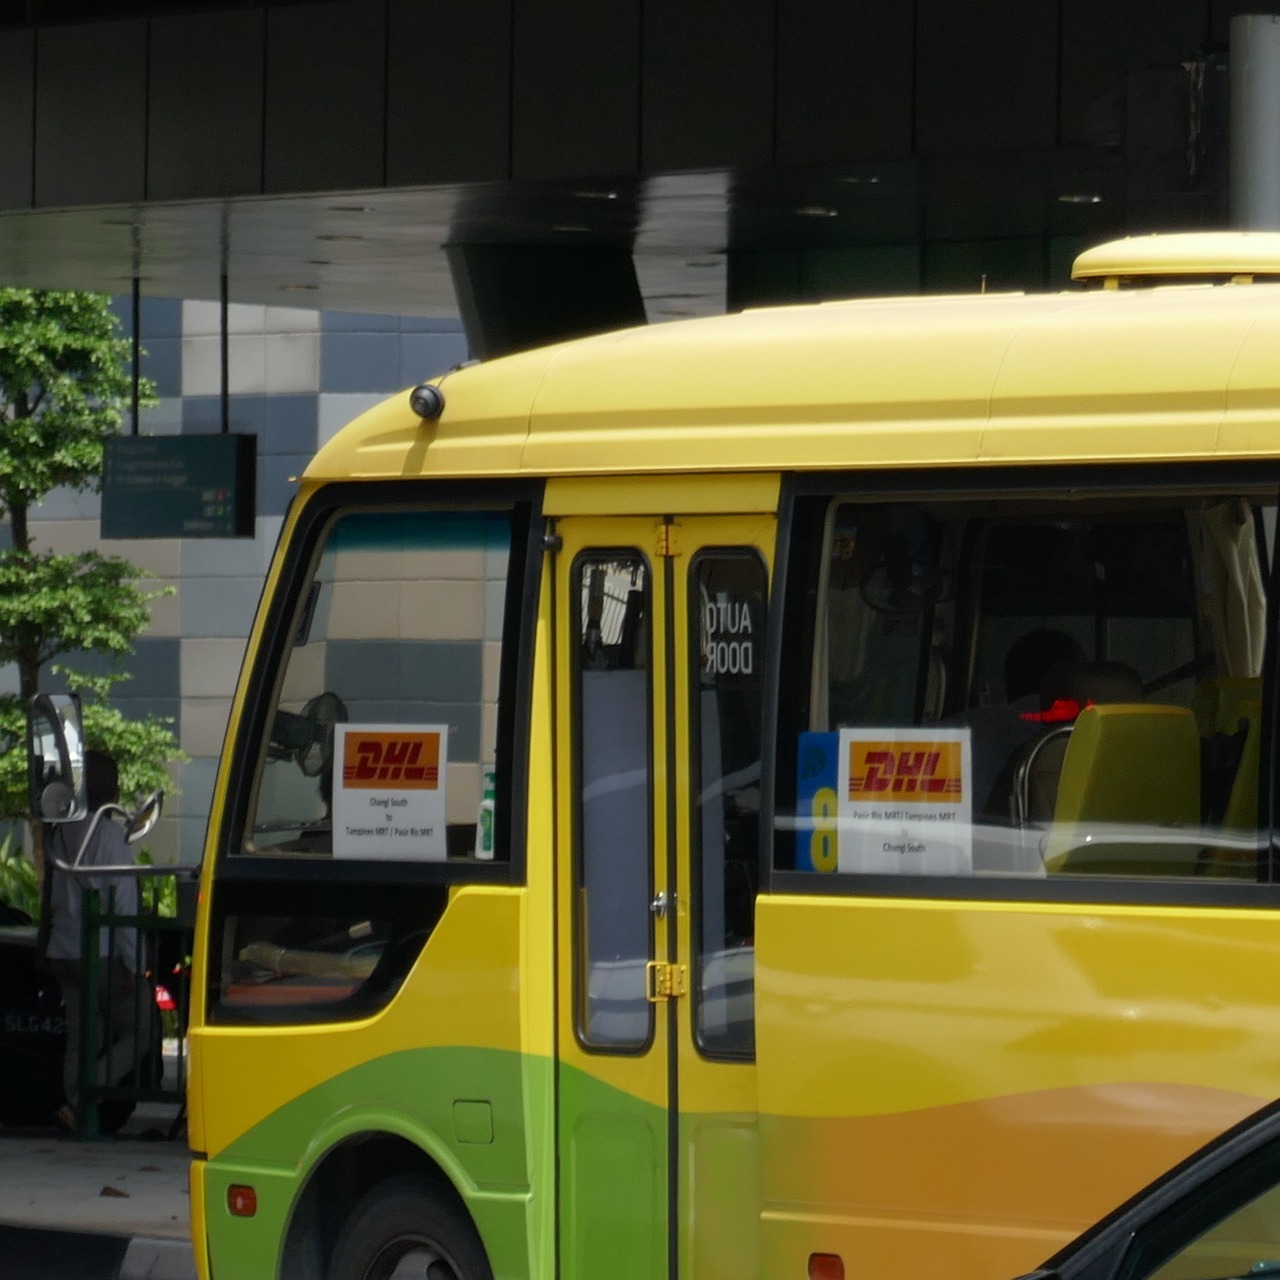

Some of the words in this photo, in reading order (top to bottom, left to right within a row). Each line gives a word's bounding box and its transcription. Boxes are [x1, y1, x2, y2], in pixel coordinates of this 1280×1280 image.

[354, 741, 426, 780] DHL
[862, 751, 947, 792] DHL
[369, 797, 389, 808] Changi
[390, 797, 408, 807] South
[853, 811, 870, 820] Pasir
[871, 811, 883, 820] Ris
[904, 811, 937, 822] Tampines
[938, 812, 956, 820] MRT
[346, 826, 374, 837] Tampines
[375, 827, 389, 836] MRT
[394, 828, 408, 836] Pasir
[410, 828, 419, 836] Ris
[420, 828, 433, 836] MRT
[907, 843, 926, 852] South
